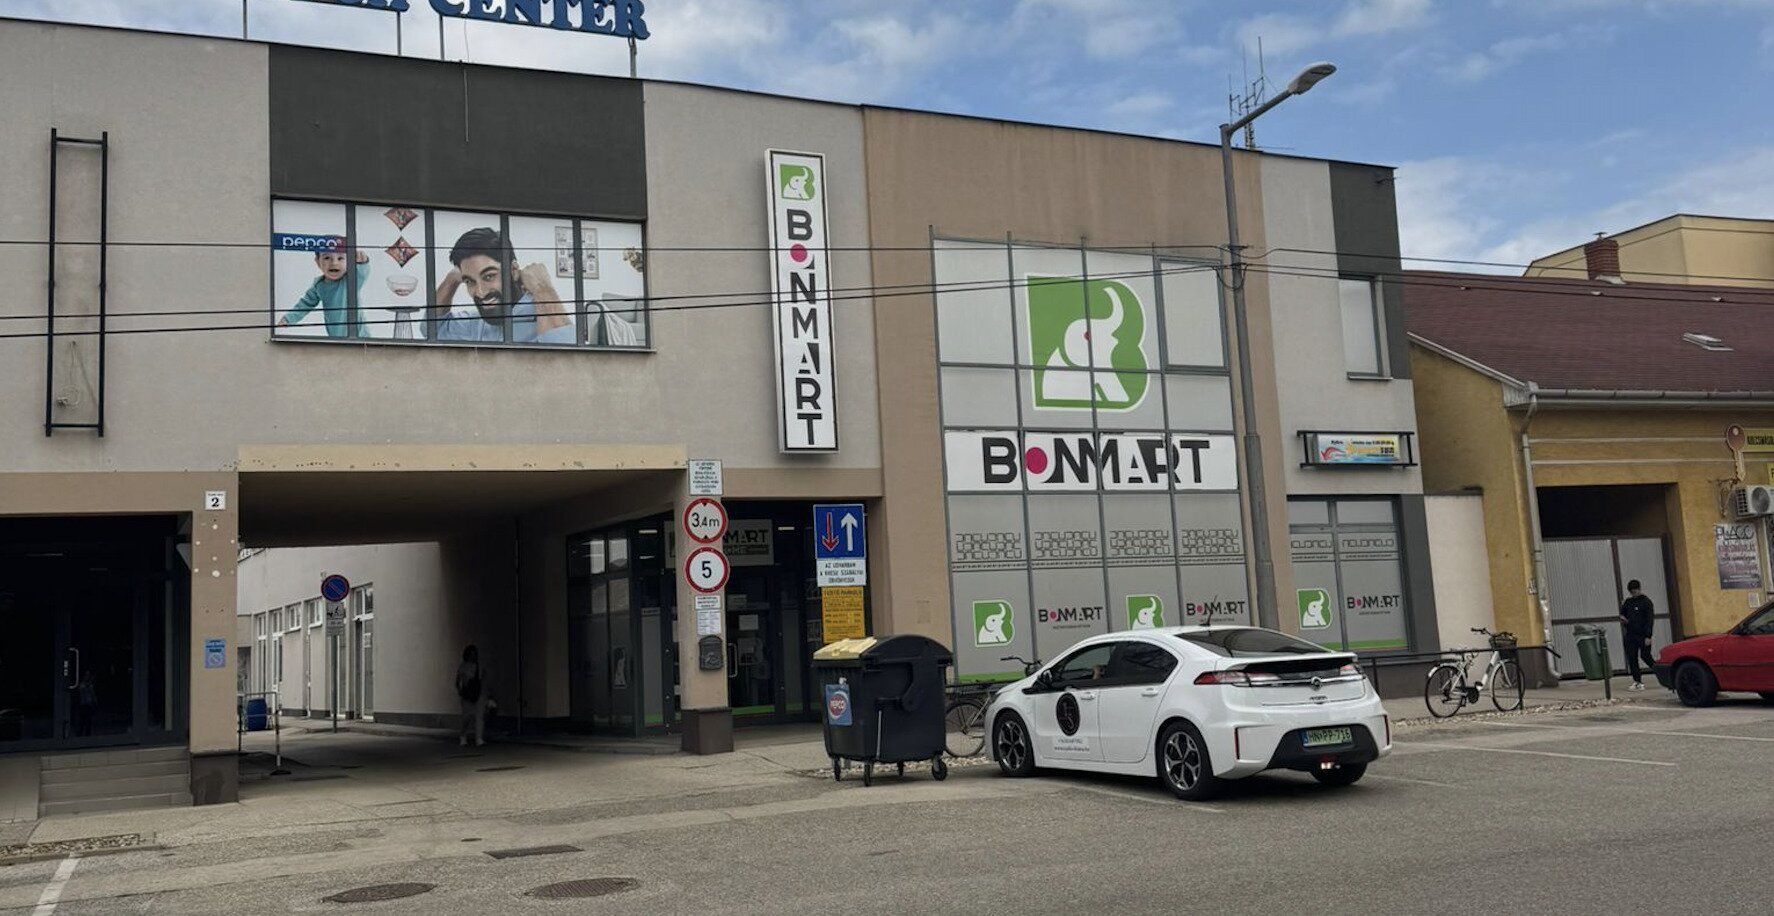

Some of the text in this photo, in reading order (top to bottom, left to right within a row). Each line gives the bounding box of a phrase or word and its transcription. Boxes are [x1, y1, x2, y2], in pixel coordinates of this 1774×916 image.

[282, 236, 338, 251] pepco
[786, 208, 823, 446] BONMART
[981, 436, 1210, 485] BONMART
[211, 497, 220, 508] 2
[701, 560, 712, 578] 5
